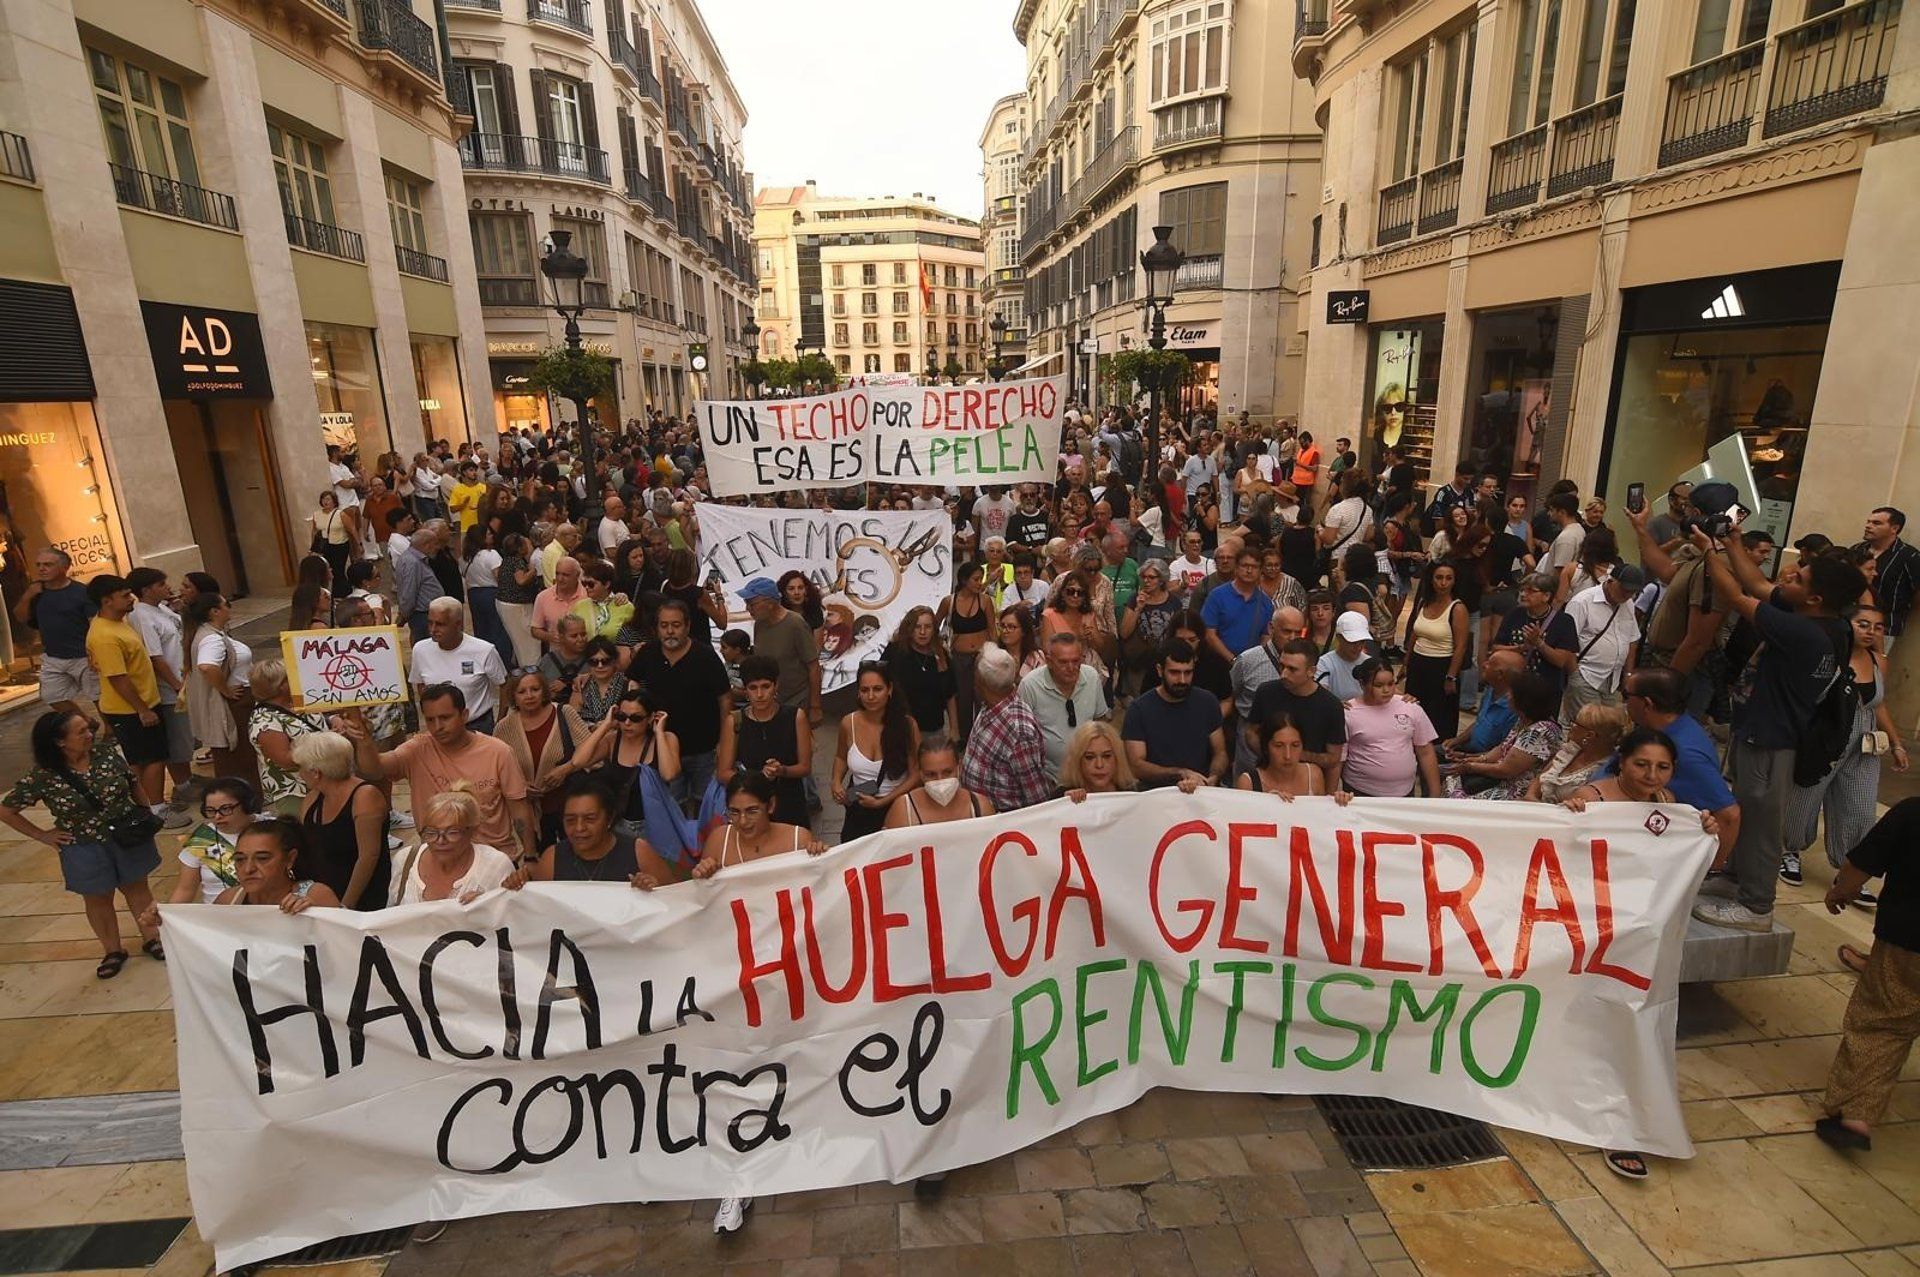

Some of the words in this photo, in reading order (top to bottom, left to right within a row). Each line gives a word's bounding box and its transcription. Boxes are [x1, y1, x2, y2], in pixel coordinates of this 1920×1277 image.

[472, 198, 529, 211] OTEL
[180, 315, 232, 356] AD
[1171, 326, 1206, 341] Etam
[708, 405, 760, 446] UN
[767, 393, 869, 441] TECHO
[873, 401, 912, 428] POR
[922, 382, 1057, 431] DERECHO
[753, 444, 814, 486] ESA
[829, 438, 863, 480] ES
[876, 434, 921, 476] LA
[929, 423, 1044, 476] PELEA
[71, 548, 106, 567] ICES
[702, 518, 886, 583] TENEMOS
[810, 568, 878, 599] AVES
[302, 636, 390, 659] MÁLAGA
[354, 684, 401, 703] AMOS
[232, 928, 602, 1095] HACIA
[638, 976, 715, 1036] LA
[731, 827, 1106, 1027] HUELGA
[1149, 819, 1651, 991] GENERAL
[437, 1043, 791, 1174] contra
[838, 1001, 951, 1126] el
[1006, 958, 1541, 1120] RENTISMO
